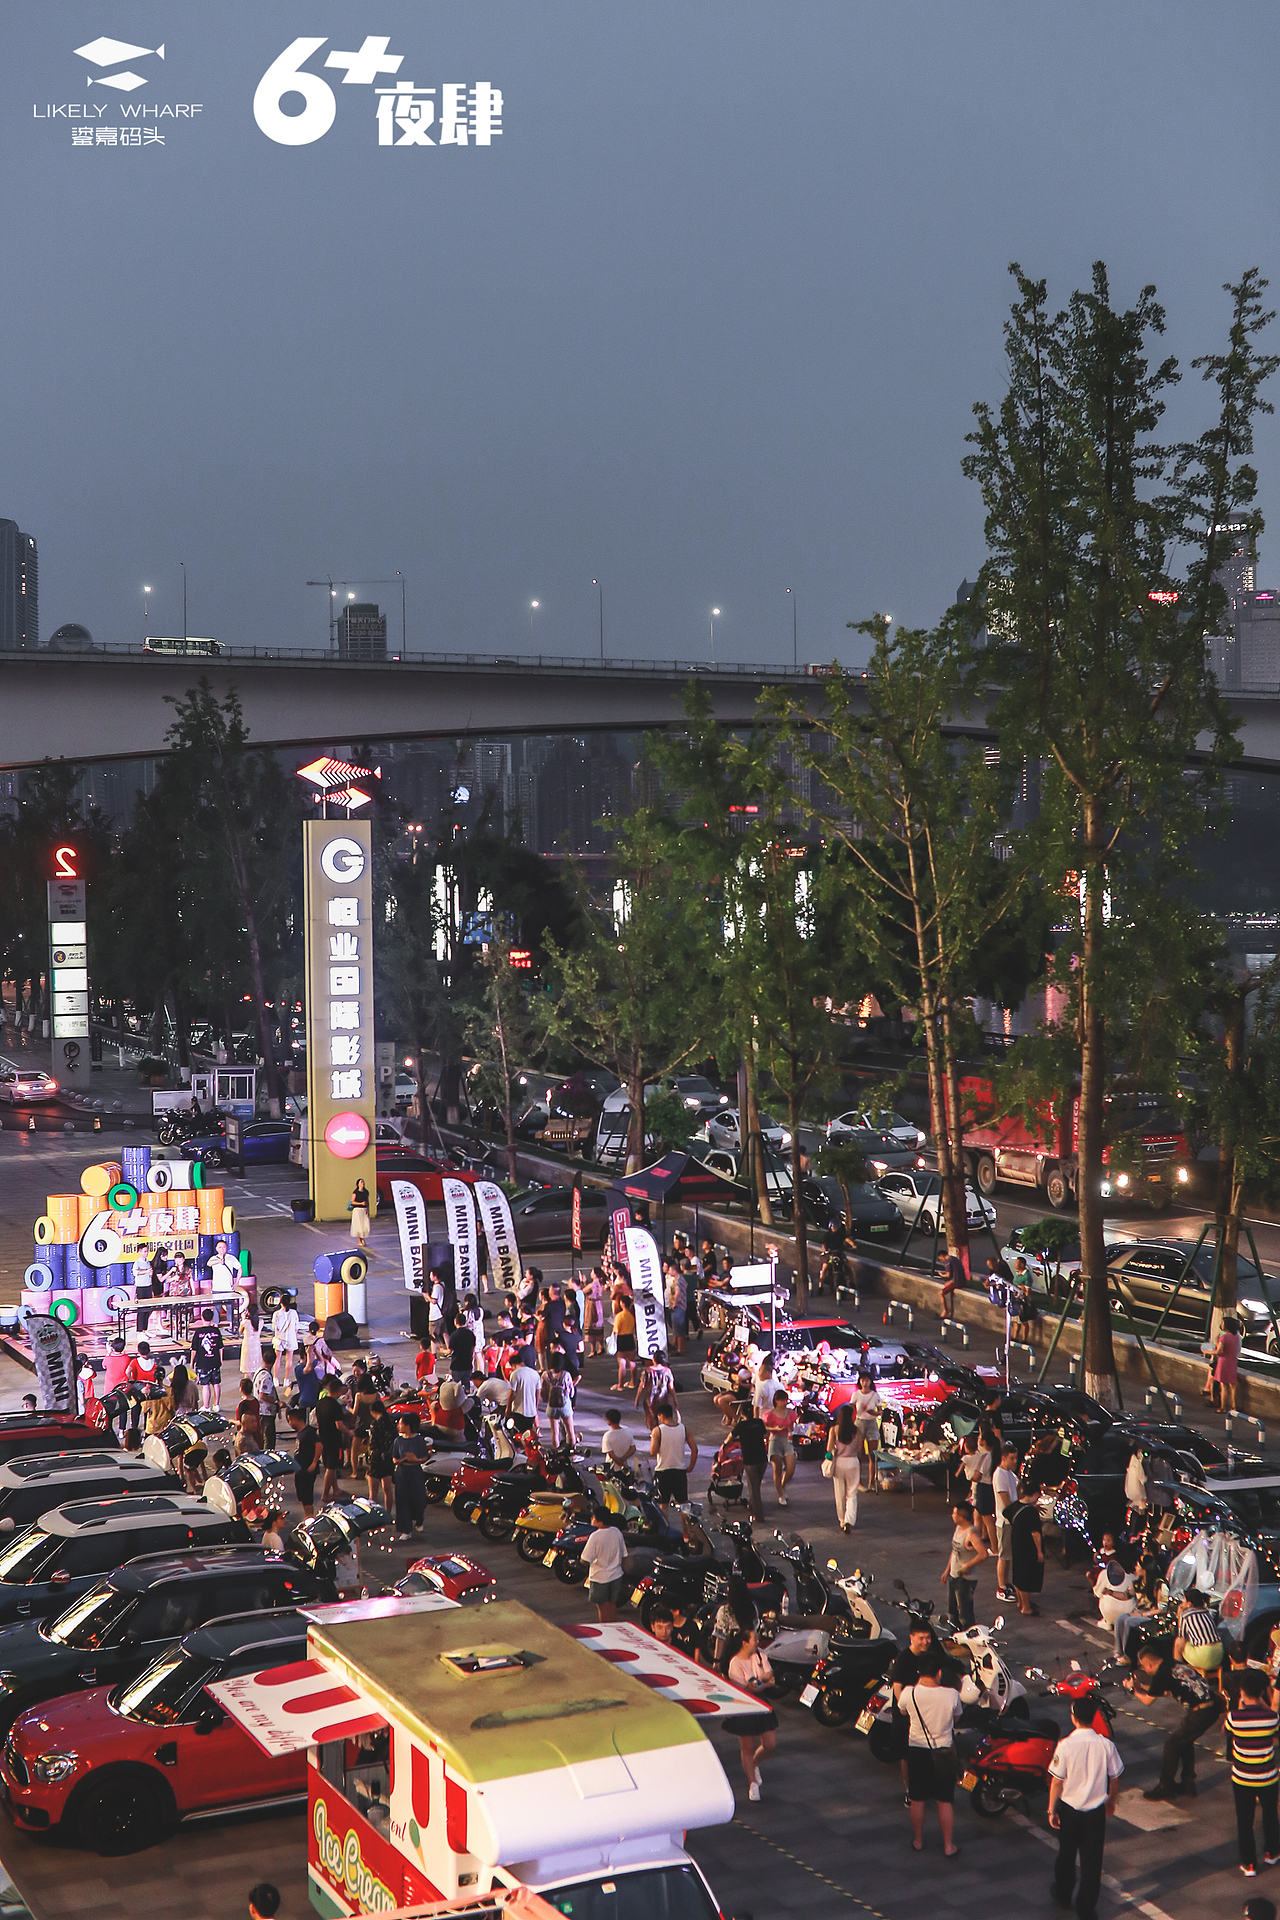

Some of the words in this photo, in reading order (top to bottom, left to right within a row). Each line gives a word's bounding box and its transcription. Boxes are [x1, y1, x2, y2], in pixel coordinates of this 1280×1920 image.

[328, 897, 361, 1098] 恒业国际影城
[380, 1066, 393, 1083] P
[405, 1206, 420, 1241] MINI
[455, 1205, 469, 1240] MINI
[490, 1206, 507, 1241] MINI
[459, 1245, 471, 1289] BANG
[497, 1245, 515, 1289] BANG
[639, 1258, 653, 1300] MINI
[644, 1304, 660, 1355] BANG
[46, 1351, 69, 1402] MINI
[222, 1680, 253, 1698] You
[238, 1701, 260, 1712] are
[249, 1714, 275, 1728] my
[315, 1802, 343, 1879] Ice
[345, 1832, 396, 1913] Cream
